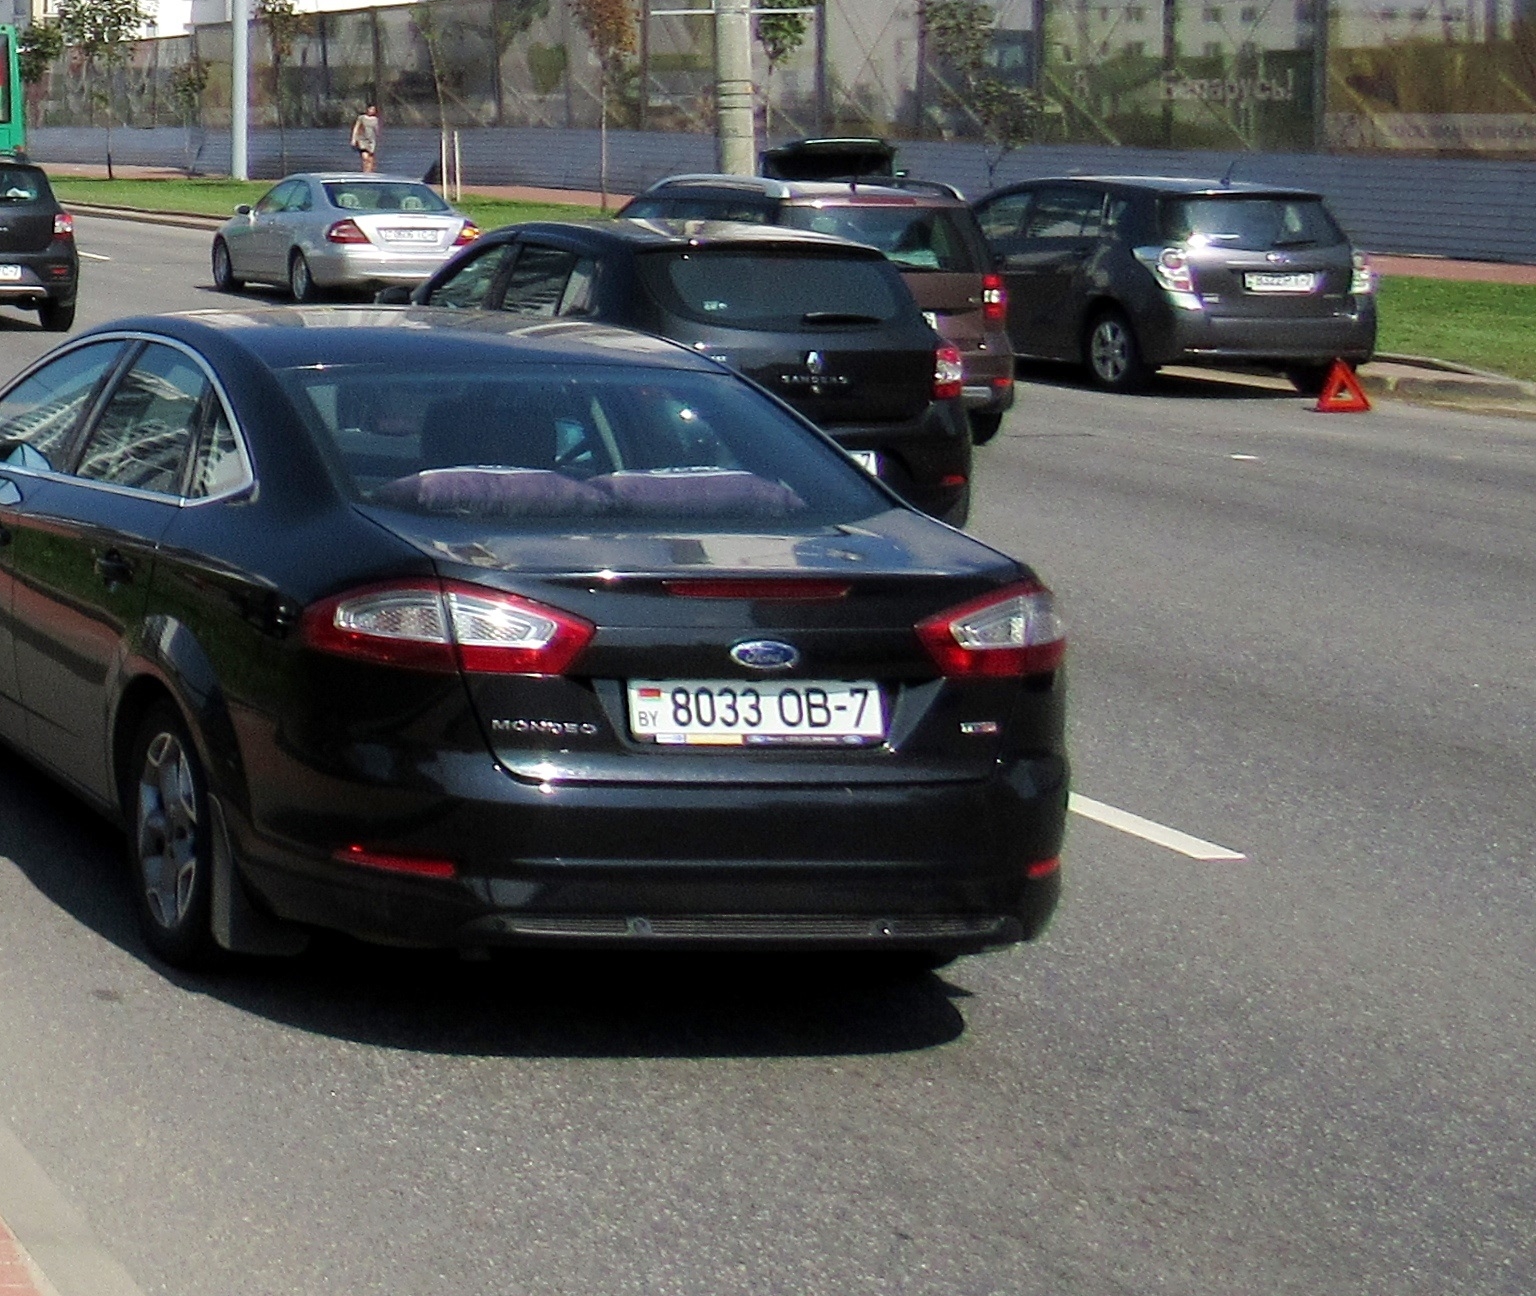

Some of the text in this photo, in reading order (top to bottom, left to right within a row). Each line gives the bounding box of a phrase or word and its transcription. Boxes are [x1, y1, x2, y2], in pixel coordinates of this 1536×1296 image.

[671, 686, 869, 728] 8033 OB-7
[491, 718, 598, 735] MONDEO
[638, 711, 658, 728] BY
